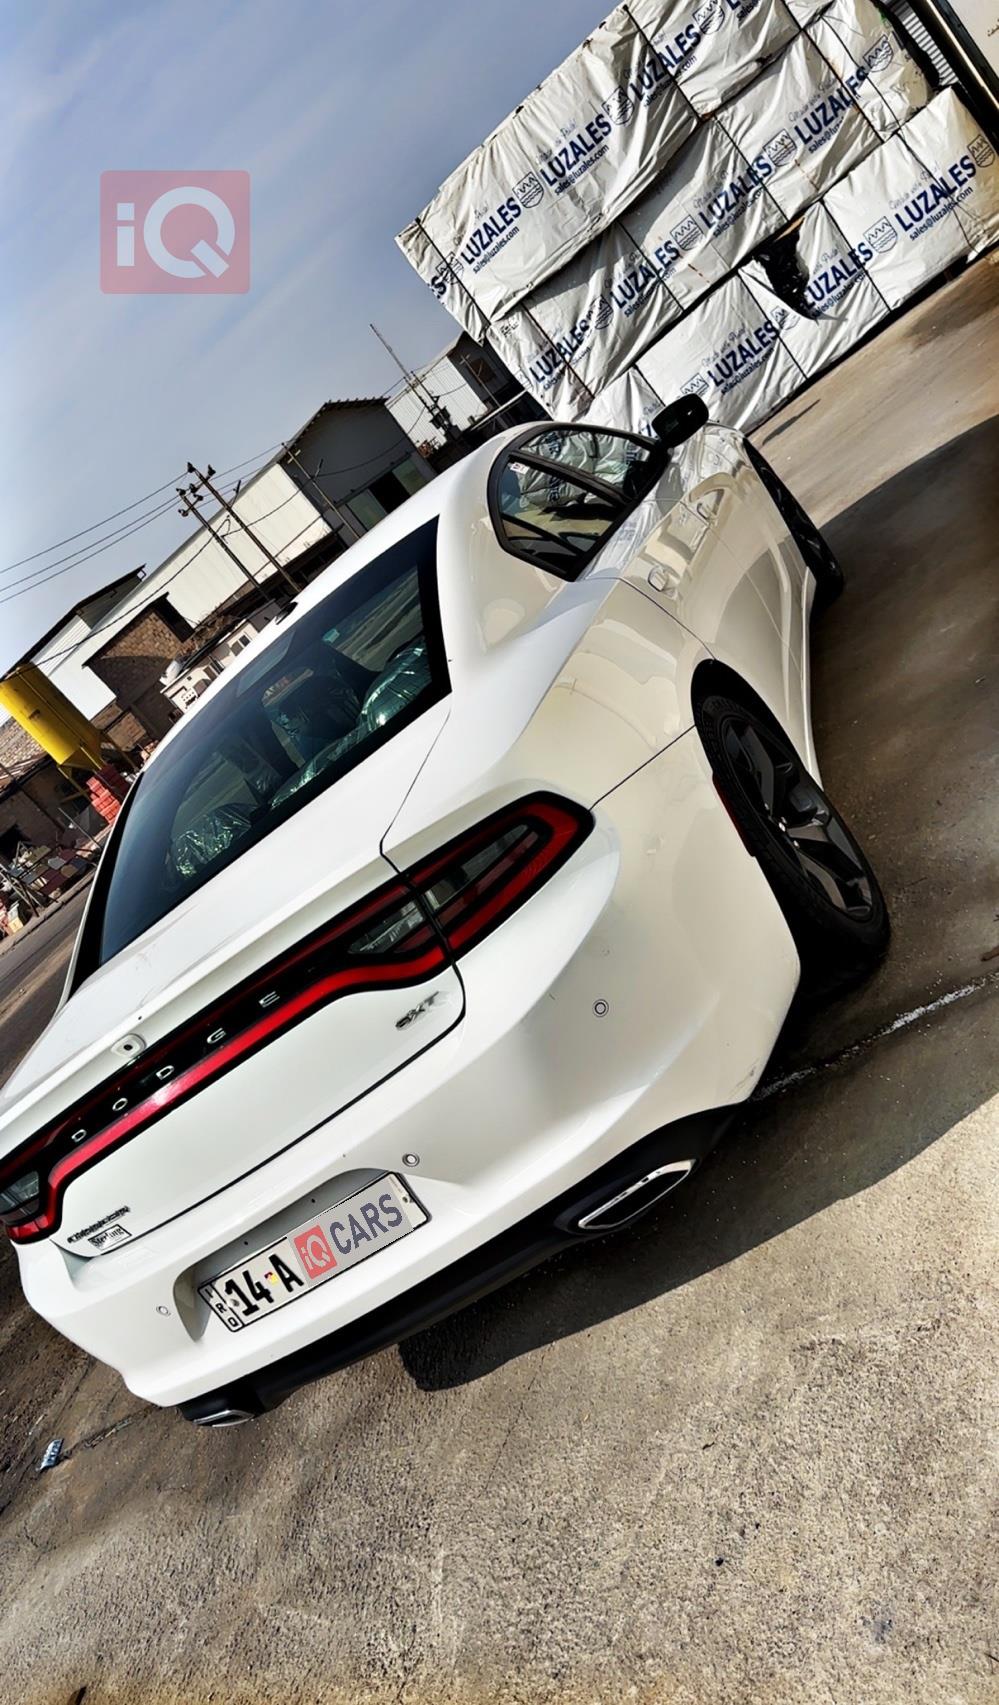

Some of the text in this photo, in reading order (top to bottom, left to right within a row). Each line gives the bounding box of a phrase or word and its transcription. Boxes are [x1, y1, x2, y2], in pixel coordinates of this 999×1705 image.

[629, 23, 701, 101] LUZALES
[540, 113, 613, 187] LUZALES
[698, 155, 773, 230] LUZALES
[894, 155, 977, 232] LUZALES
[460, 196, 522, 265] LUZALES
[609, 240, 681, 310] LUZALES
[707, 319, 780, 388] LUZALES
[71, 991, 281, 1143] DODGE
